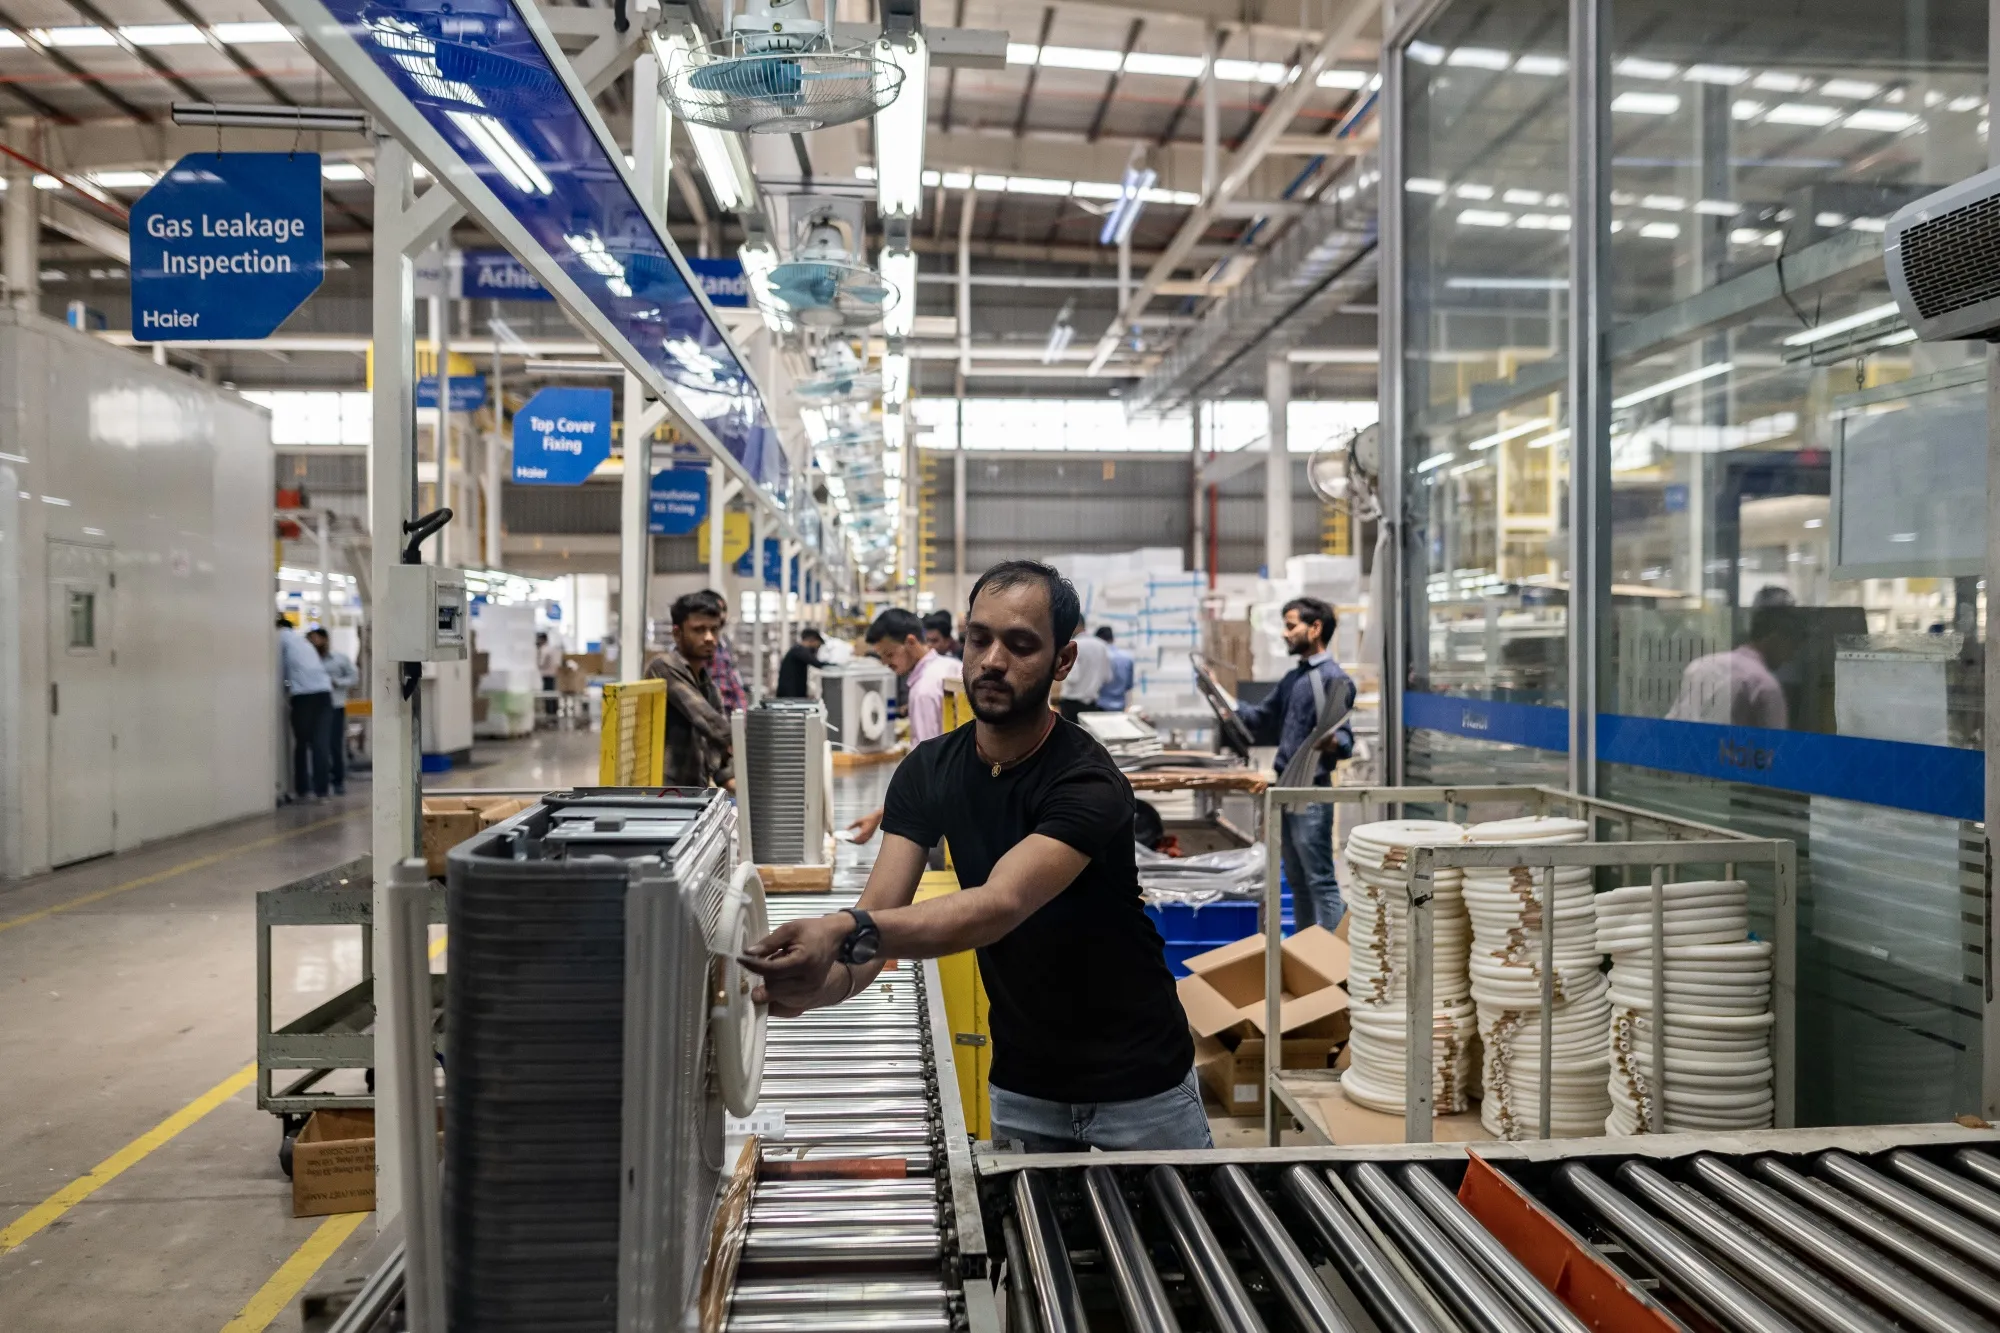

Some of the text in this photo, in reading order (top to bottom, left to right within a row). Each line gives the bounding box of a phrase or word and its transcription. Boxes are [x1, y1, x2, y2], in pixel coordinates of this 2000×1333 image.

[147, 212, 304, 243] Gas Leakage
[162, 249, 291, 280] Inspection
[477, 264, 542, 289] Achie
[143, 309, 199, 328] Haier
[530, 416, 596, 434] Top Cover
[542, 436, 582, 455] Fixing
[517, 466, 548, 479] Haier
[650, 489, 700, 501] nstallation
[1719, 738, 1775, 771] Haier
